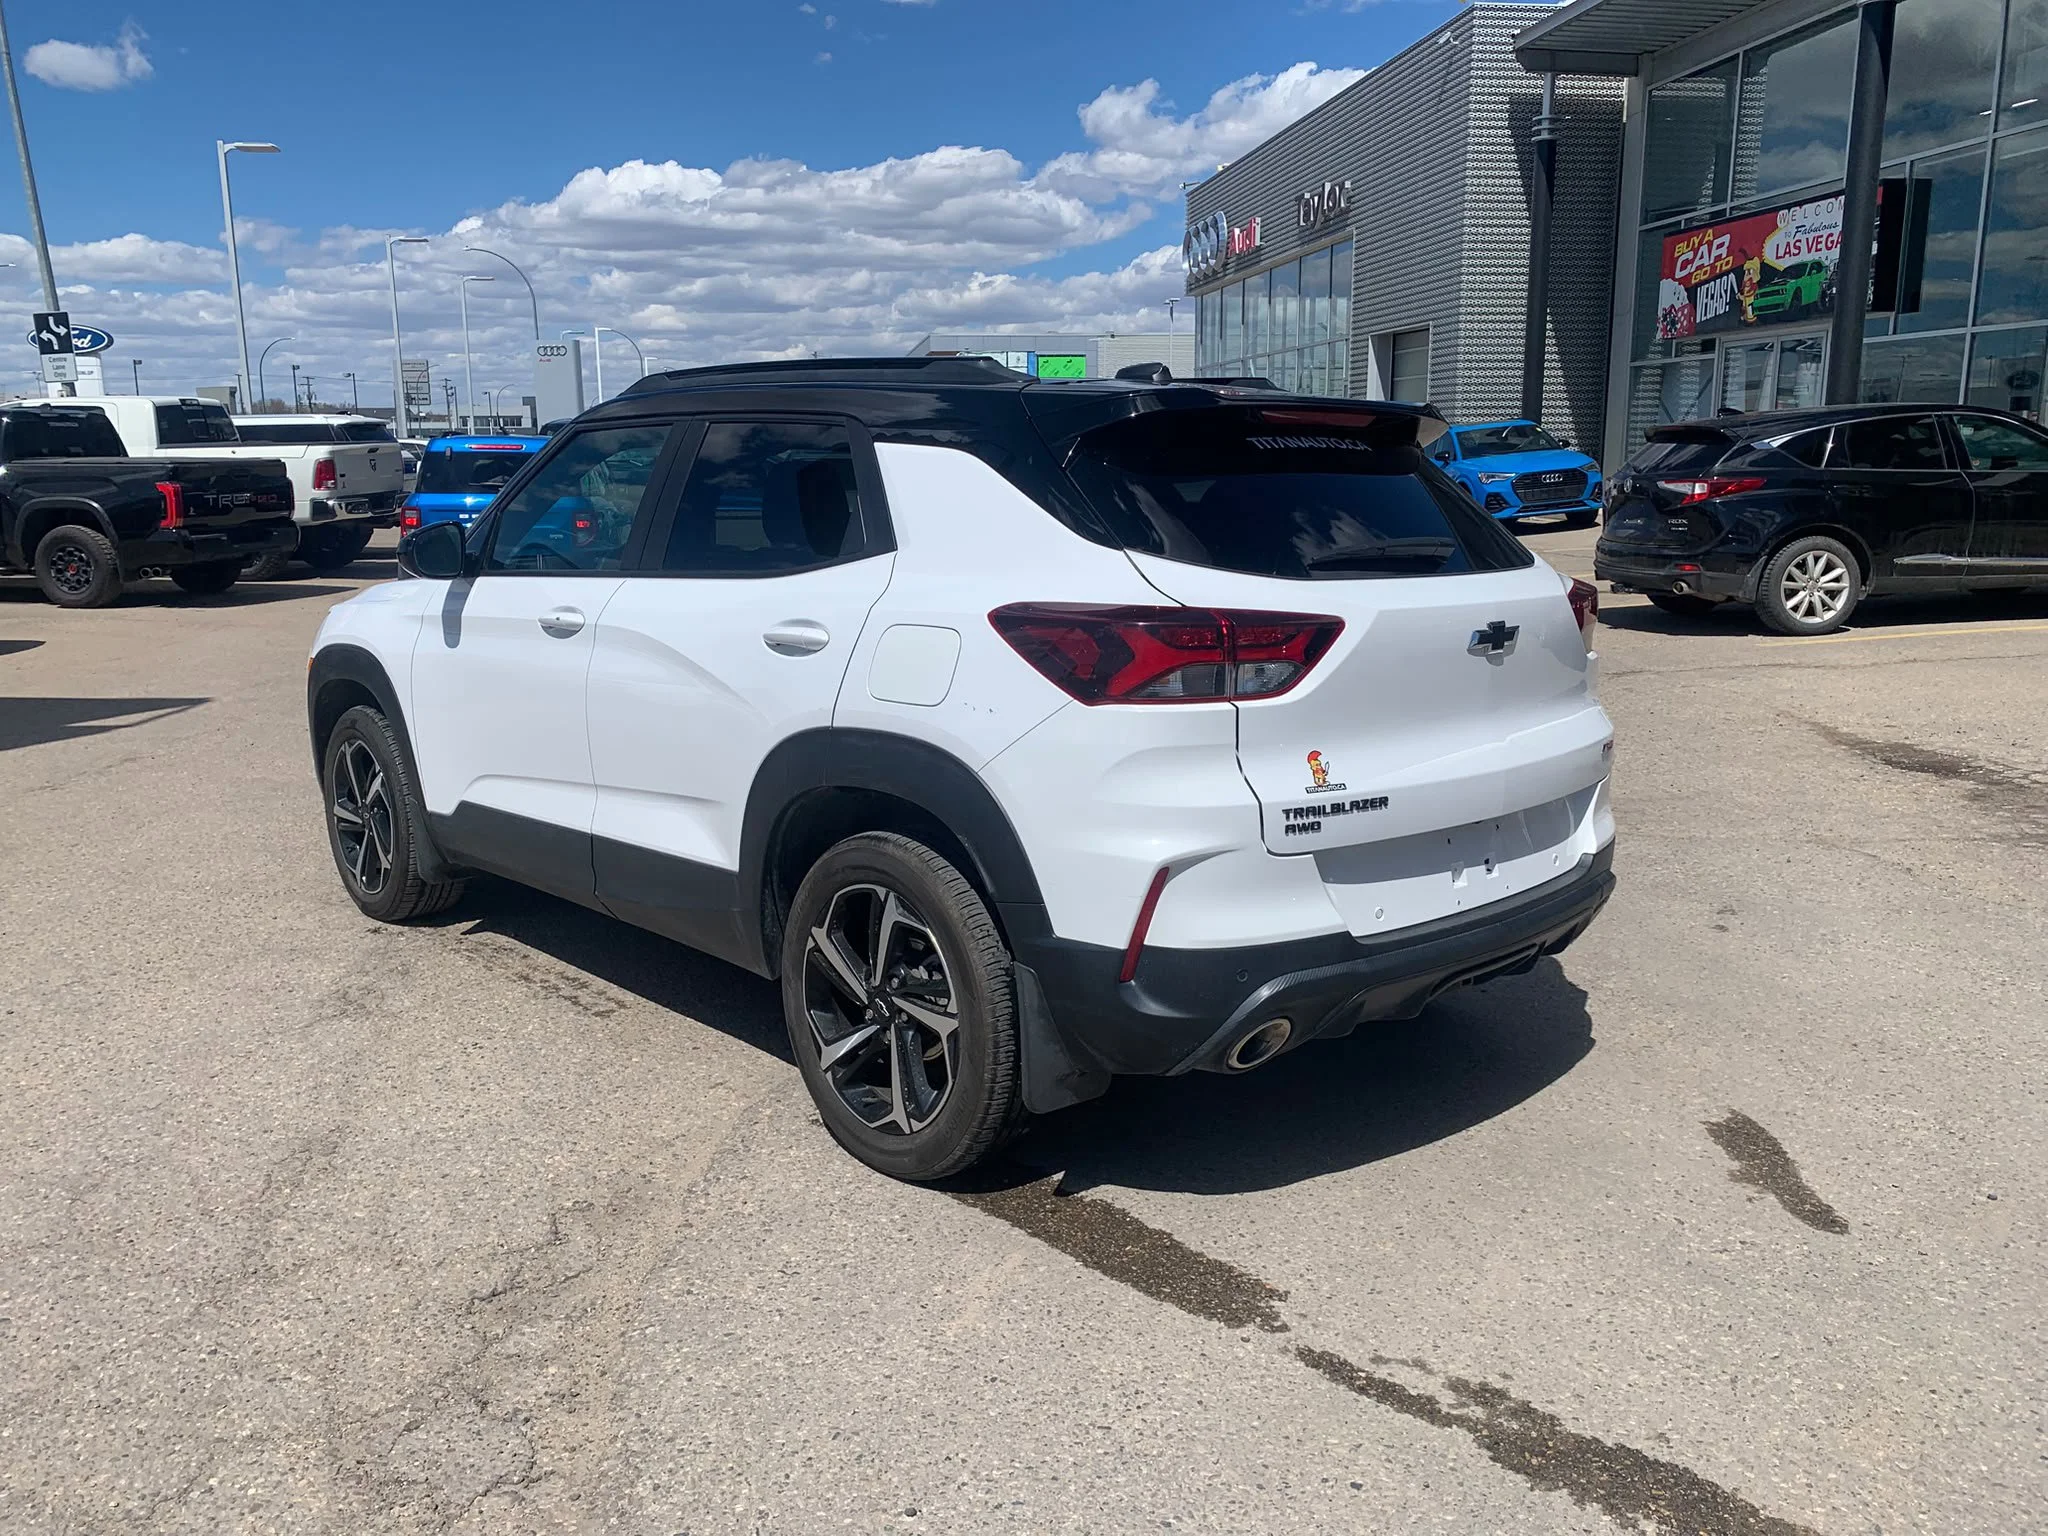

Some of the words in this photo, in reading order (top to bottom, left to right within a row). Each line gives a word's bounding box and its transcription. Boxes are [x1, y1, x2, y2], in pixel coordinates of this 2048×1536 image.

[1296, 181, 1352, 229] Taylor
[1228, 217, 1261, 257] Audi
[1674, 233, 1702, 257] BUY
[1703, 229, 1714, 244] A
[1793, 221, 1840, 239] Fabulous
[1675, 233, 1731, 279] CAR
[1775, 238, 1802, 260] LAS
[1692, 265, 1711, 285] GO
[1714, 256, 1734, 273] TO
[1696, 272, 1733, 323] VEGAS!
[53, 371, 67, 379] Only
[1246, 437, 1373, 452] TITANAUTO.CA
[1282, 796, 1389, 821] TRAILBLAZER
[1285, 821, 1322, 835] AWD
